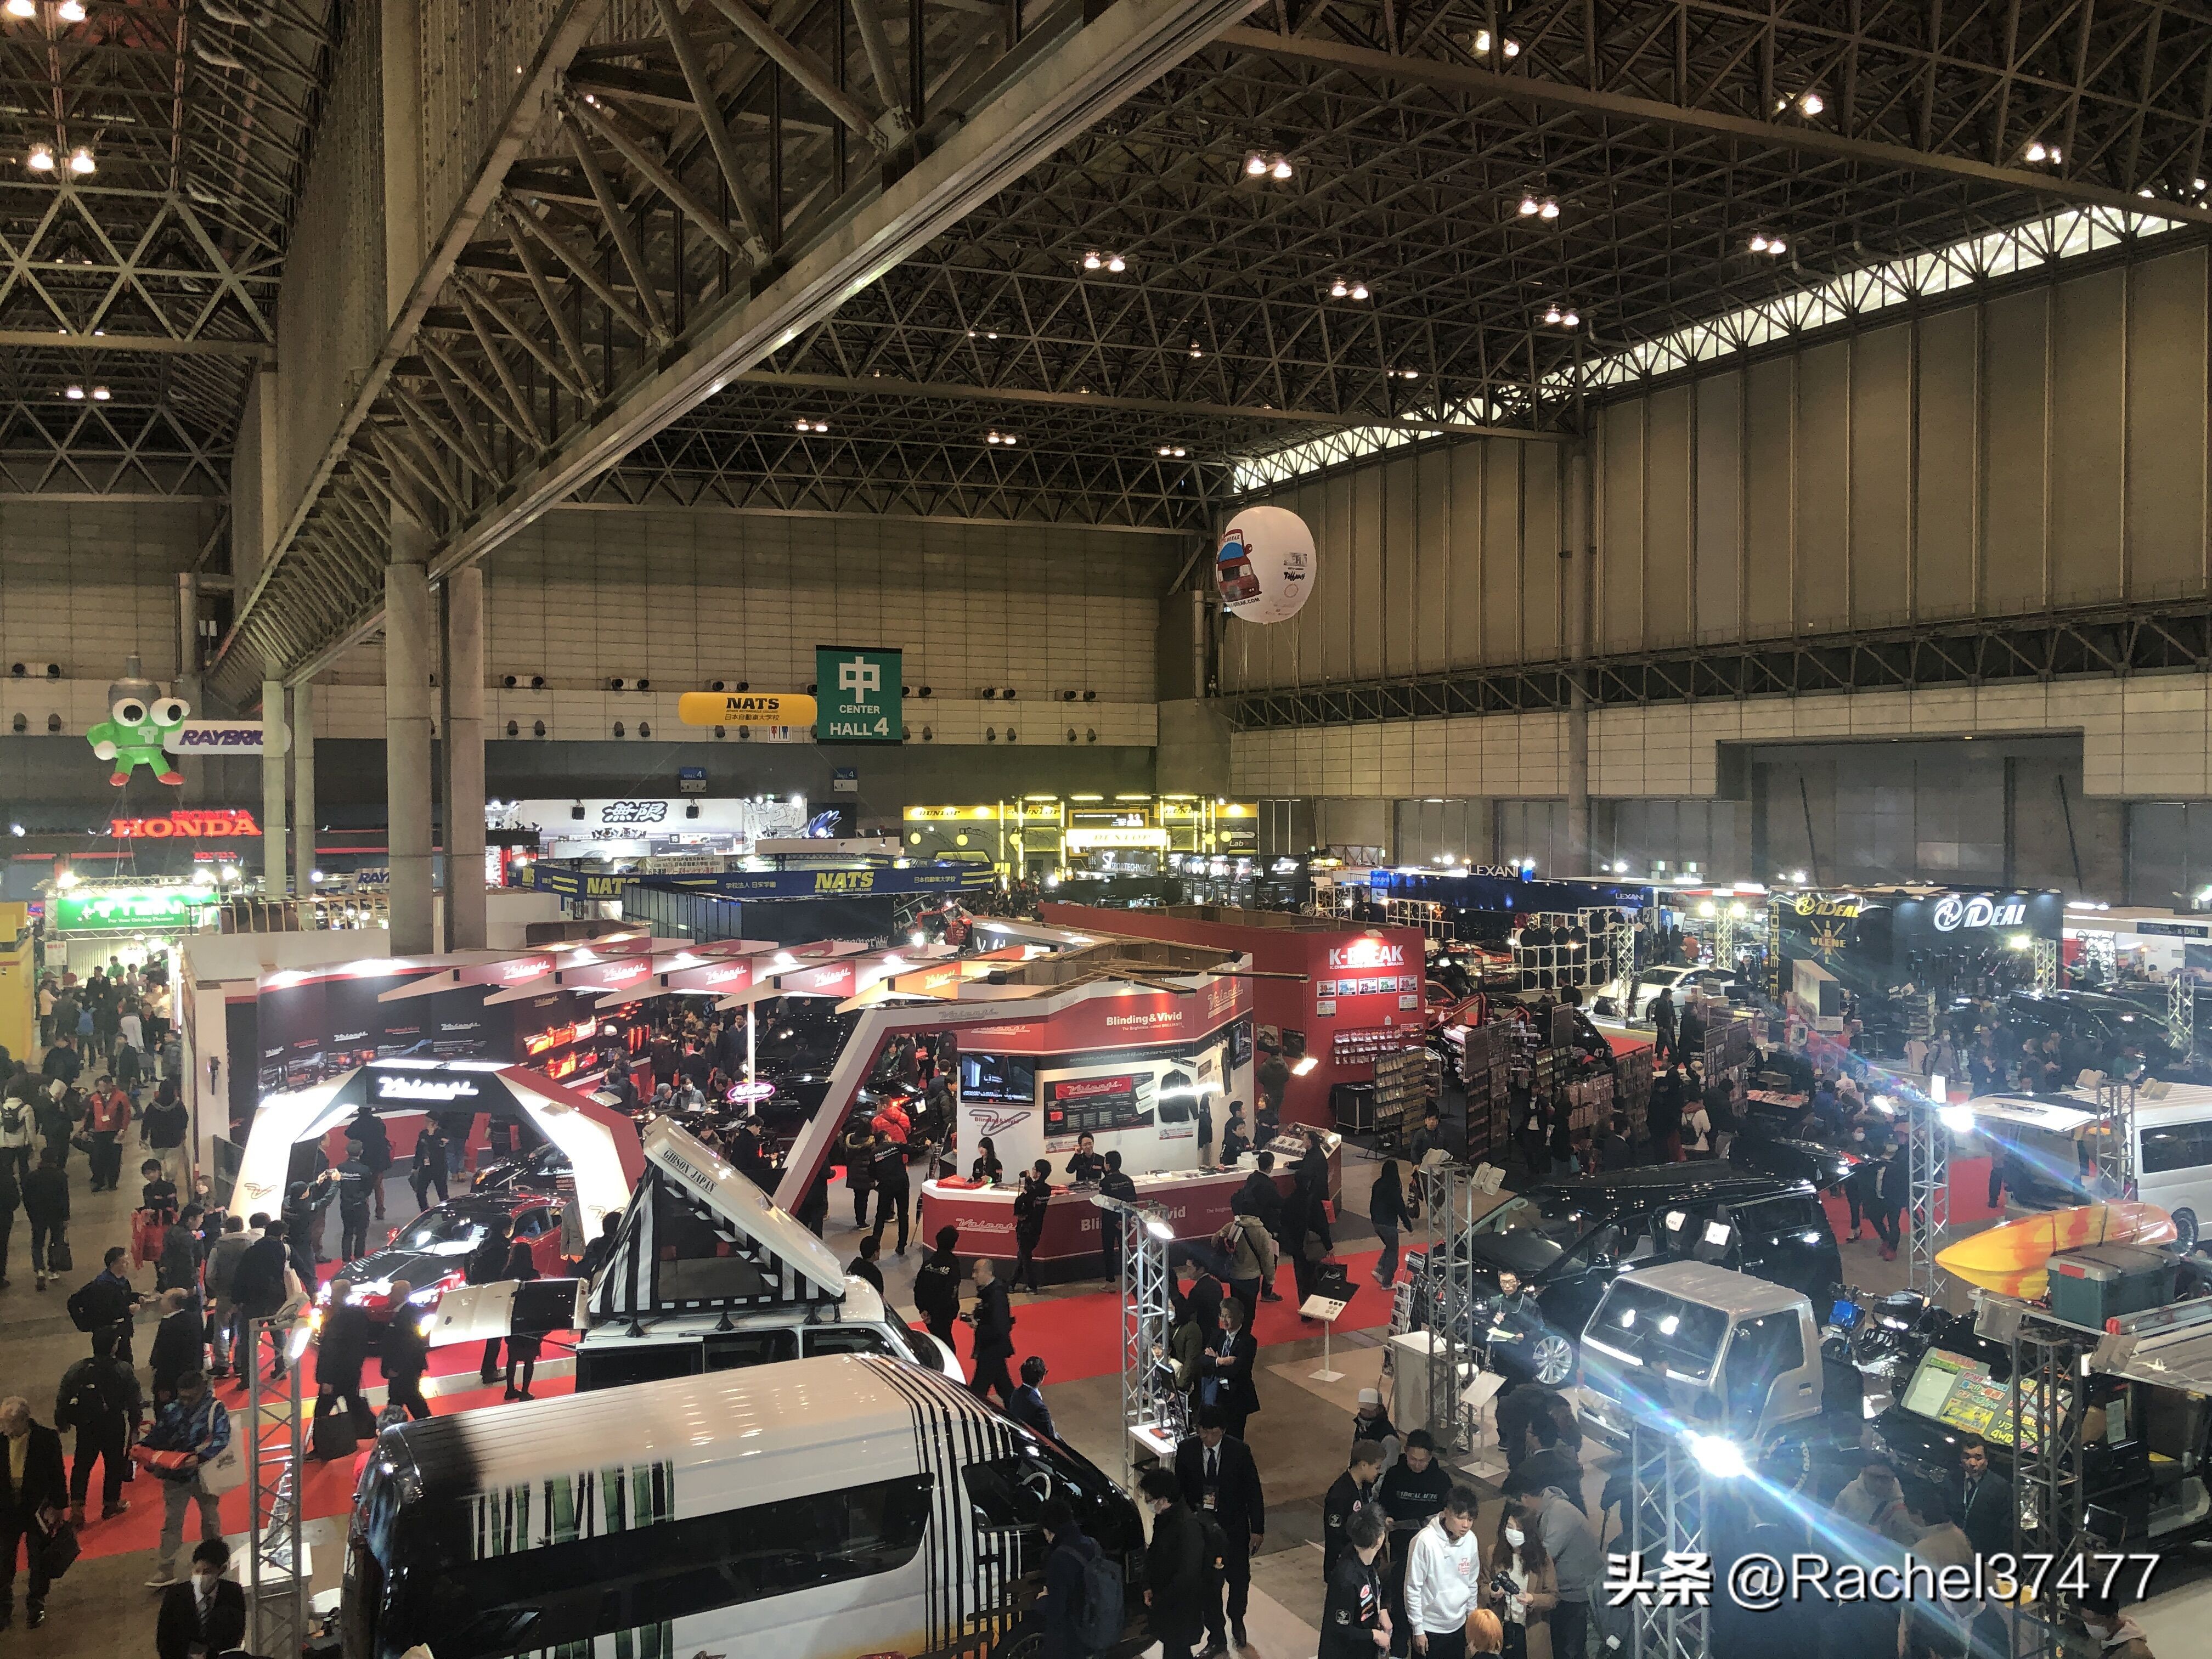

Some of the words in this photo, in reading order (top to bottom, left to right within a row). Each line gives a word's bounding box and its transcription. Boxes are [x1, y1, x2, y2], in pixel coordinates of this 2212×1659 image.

[839, 656, 880, 703] 中
[726, 697, 780, 710] NATS
[839, 704, 881, 714] CENTER
[830, 722, 872, 736] HALL
[873, 717, 889, 736] 4
[848, 770, 854, 778] 4
[603, 802, 667, 822] 無限
[111, 819, 262, 837] HONDA
[814, 871, 874, 889] NATS
[1469, 865, 1519, 878] LEXANI
[1329, 945, 1404, 965] K-BEAK
[663, 1149, 690, 1173] GIBSON
[690, 1171, 716, 1193] JAPAN
[1990, 1429, 2014, 1443] 4WD
